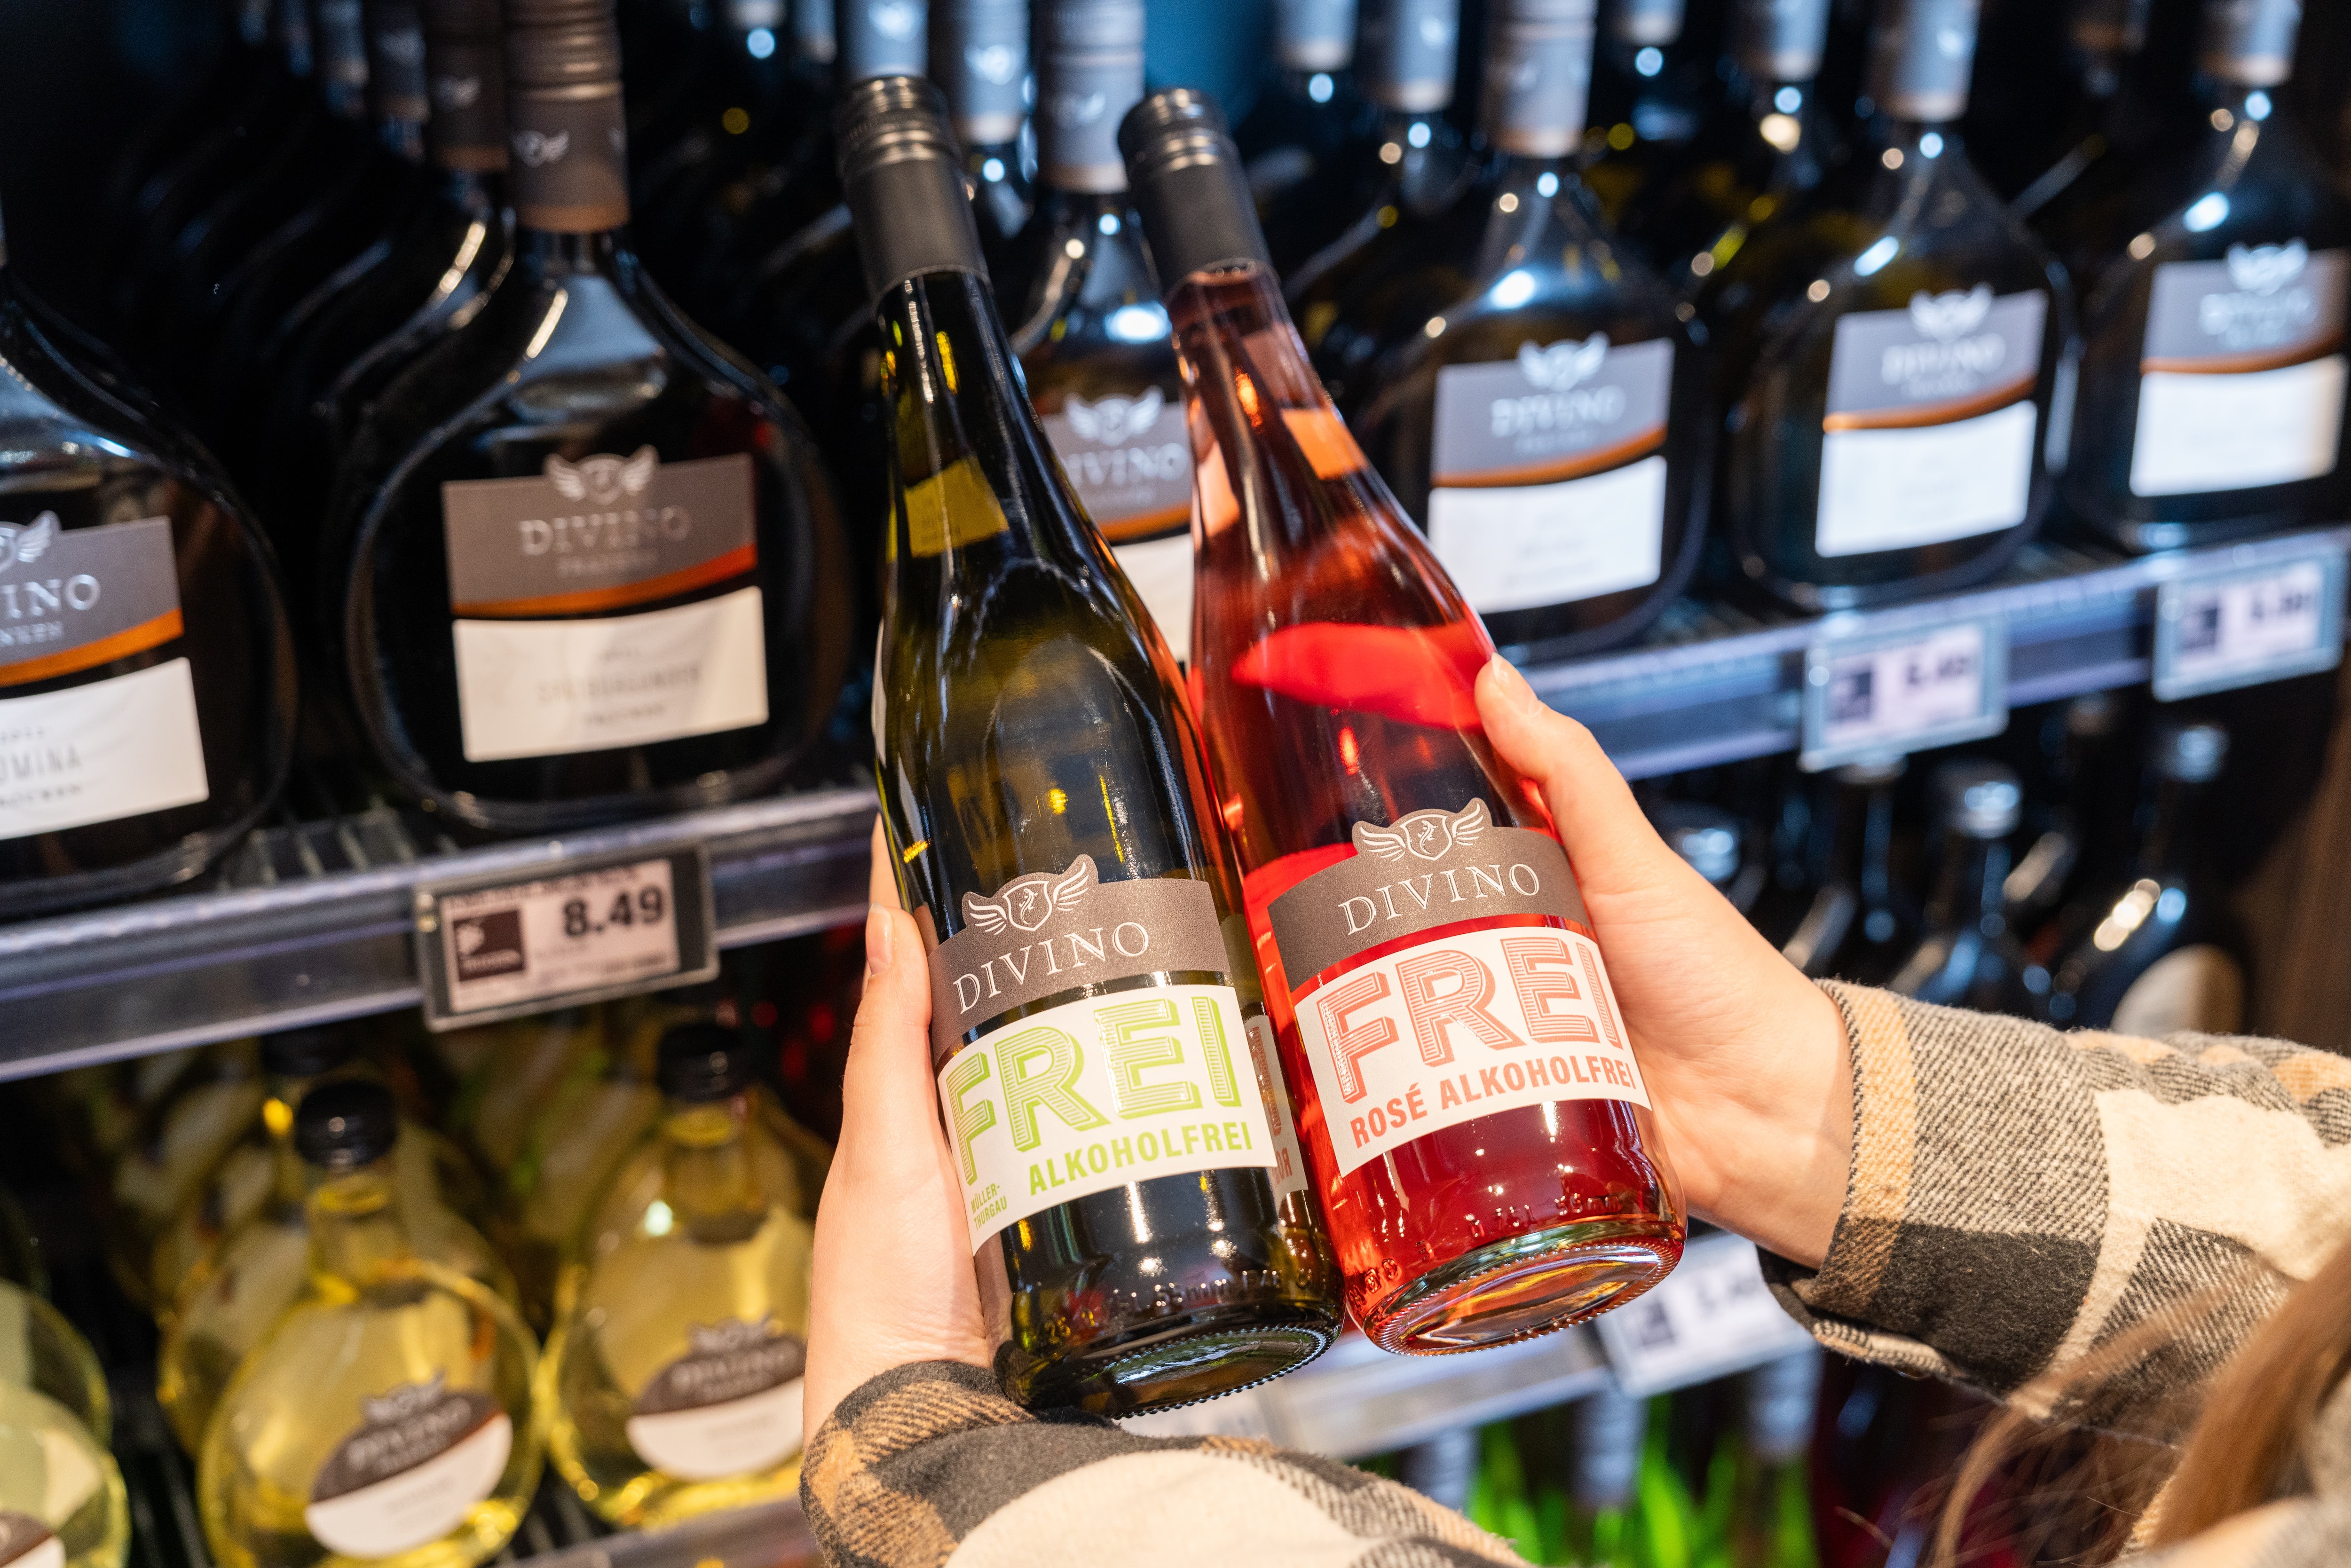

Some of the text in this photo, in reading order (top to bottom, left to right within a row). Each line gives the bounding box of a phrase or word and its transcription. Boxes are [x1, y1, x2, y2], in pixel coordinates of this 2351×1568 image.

[564, 885, 663, 938] 8.49
[1338, 863, 1540, 936] DIVINO
[953, 922, 1149, 1014] DIVINO
[1317, 937, 1624, 1104] FREI
[947, 996, 1242, 1185] FREI
[1350, 1057, 1636, 1149] ROSÉ ALKOHOLFREI
[1029, 1121, 1252, 1196] ALKOHOLFREI
[971, 1182, 1000, 1214] MÜLLER-
[974, 1195, 1007, 1230] THURGAU
